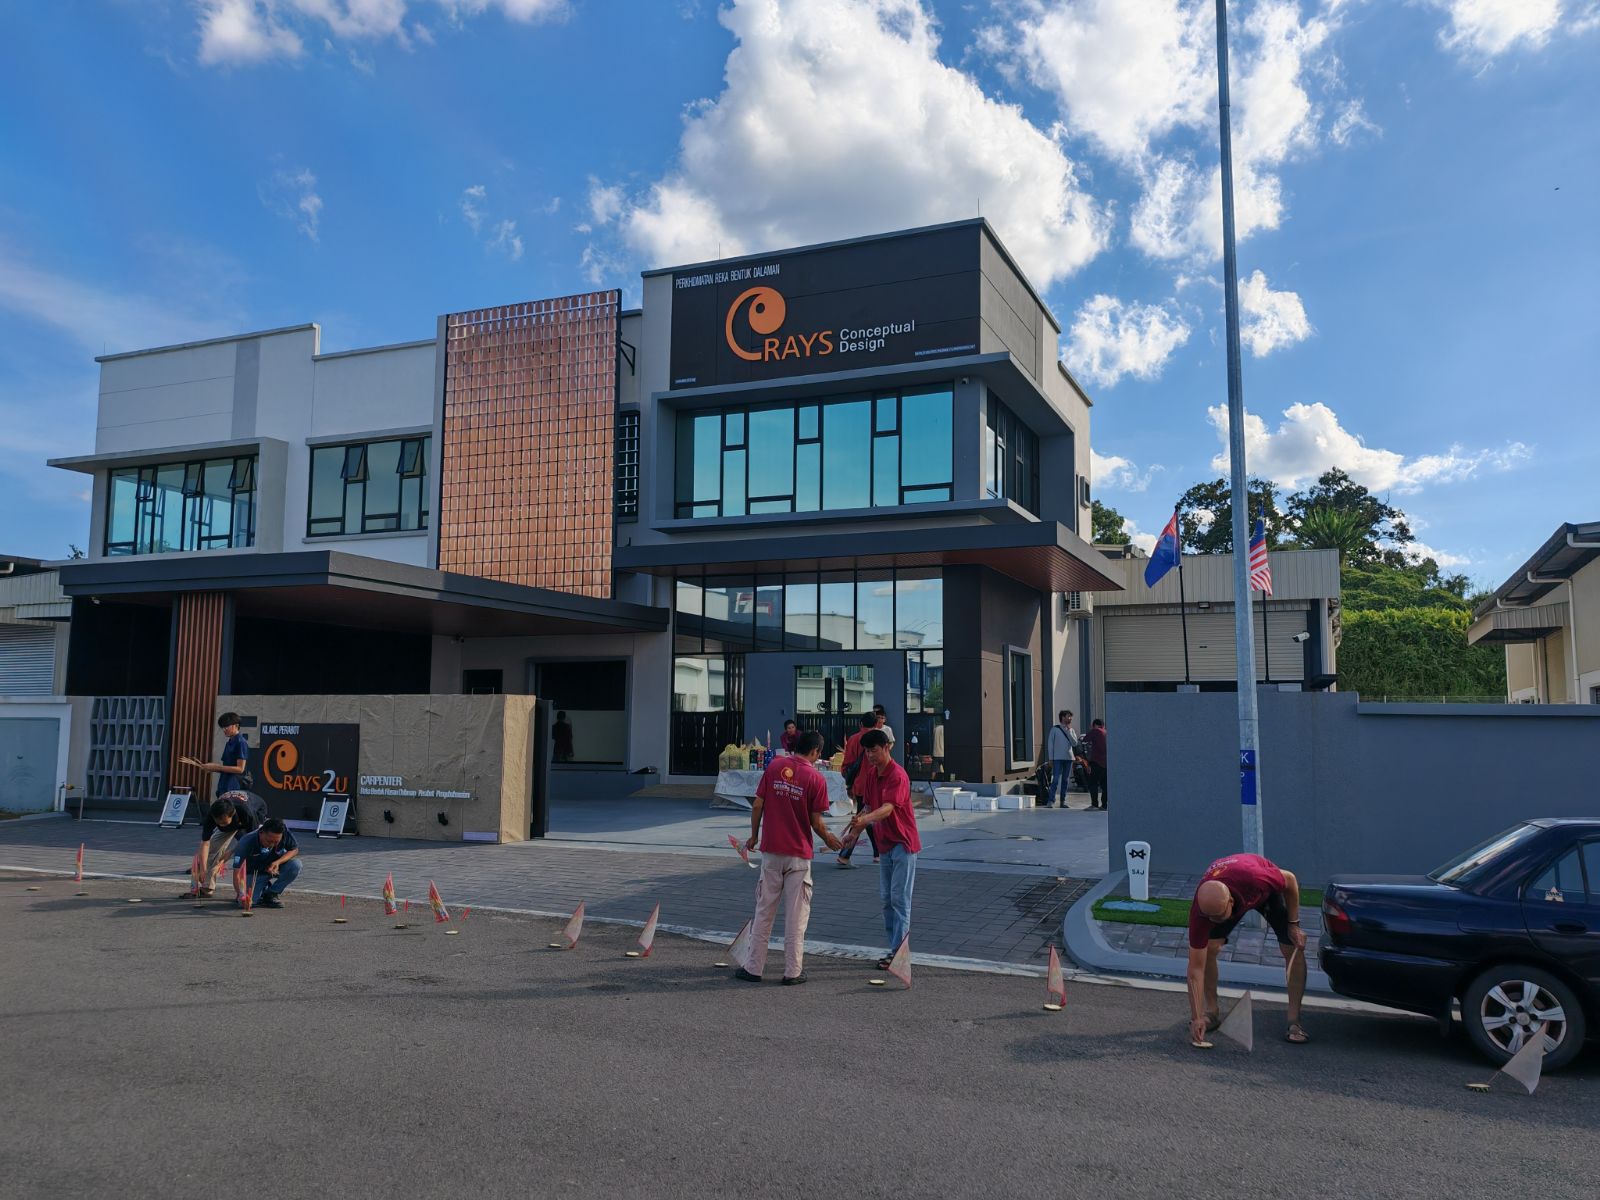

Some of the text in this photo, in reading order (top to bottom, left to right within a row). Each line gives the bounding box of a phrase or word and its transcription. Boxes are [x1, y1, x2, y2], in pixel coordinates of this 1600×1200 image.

[715, 271, 729, 284] REKA
[730, 268, 752, 282] BENTUK
[753, 263, 780, 278] DALAMAN
[839, 319, 916, 341] Conceptual
[839, 337, 886, 353] Design
[360, 775, 402, 787] CARPENTER
